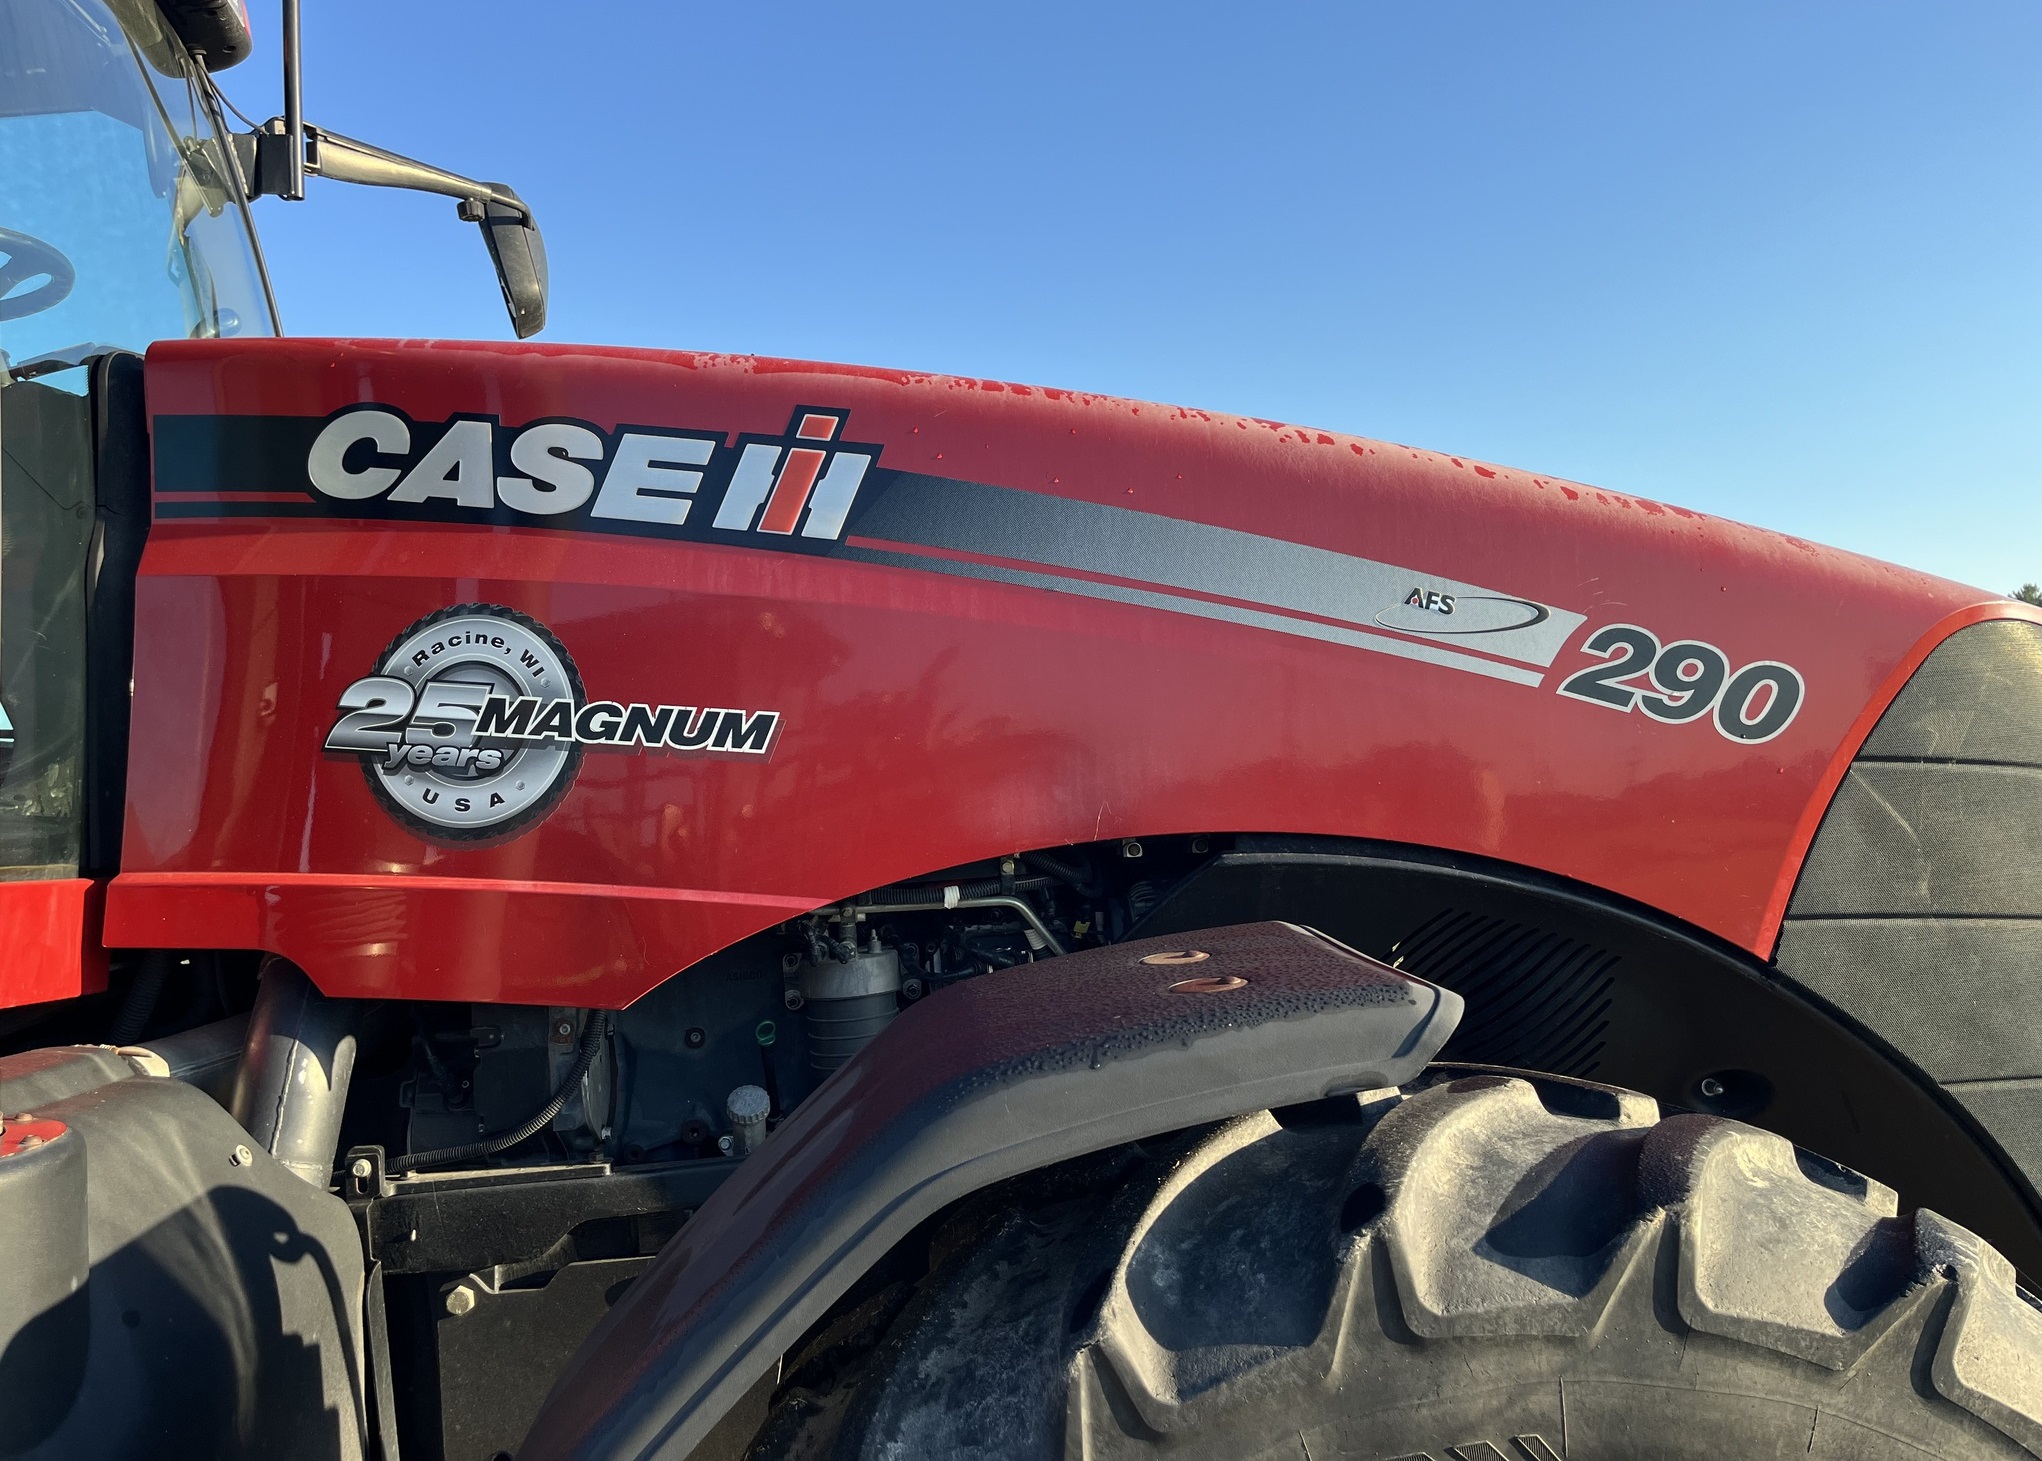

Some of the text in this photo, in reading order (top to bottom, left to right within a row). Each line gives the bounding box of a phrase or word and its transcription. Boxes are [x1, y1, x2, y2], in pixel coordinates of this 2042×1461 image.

[308, 410, 715, 525] CASE
[1403, 587, 1456, 615] AFS
[411, 631, 545, 678] Racine, WI
[1557, 624, 1805, 744] 290
[323, 676, 780, 754] 25 MAGNUM
[383, 742, 503, 771] years
